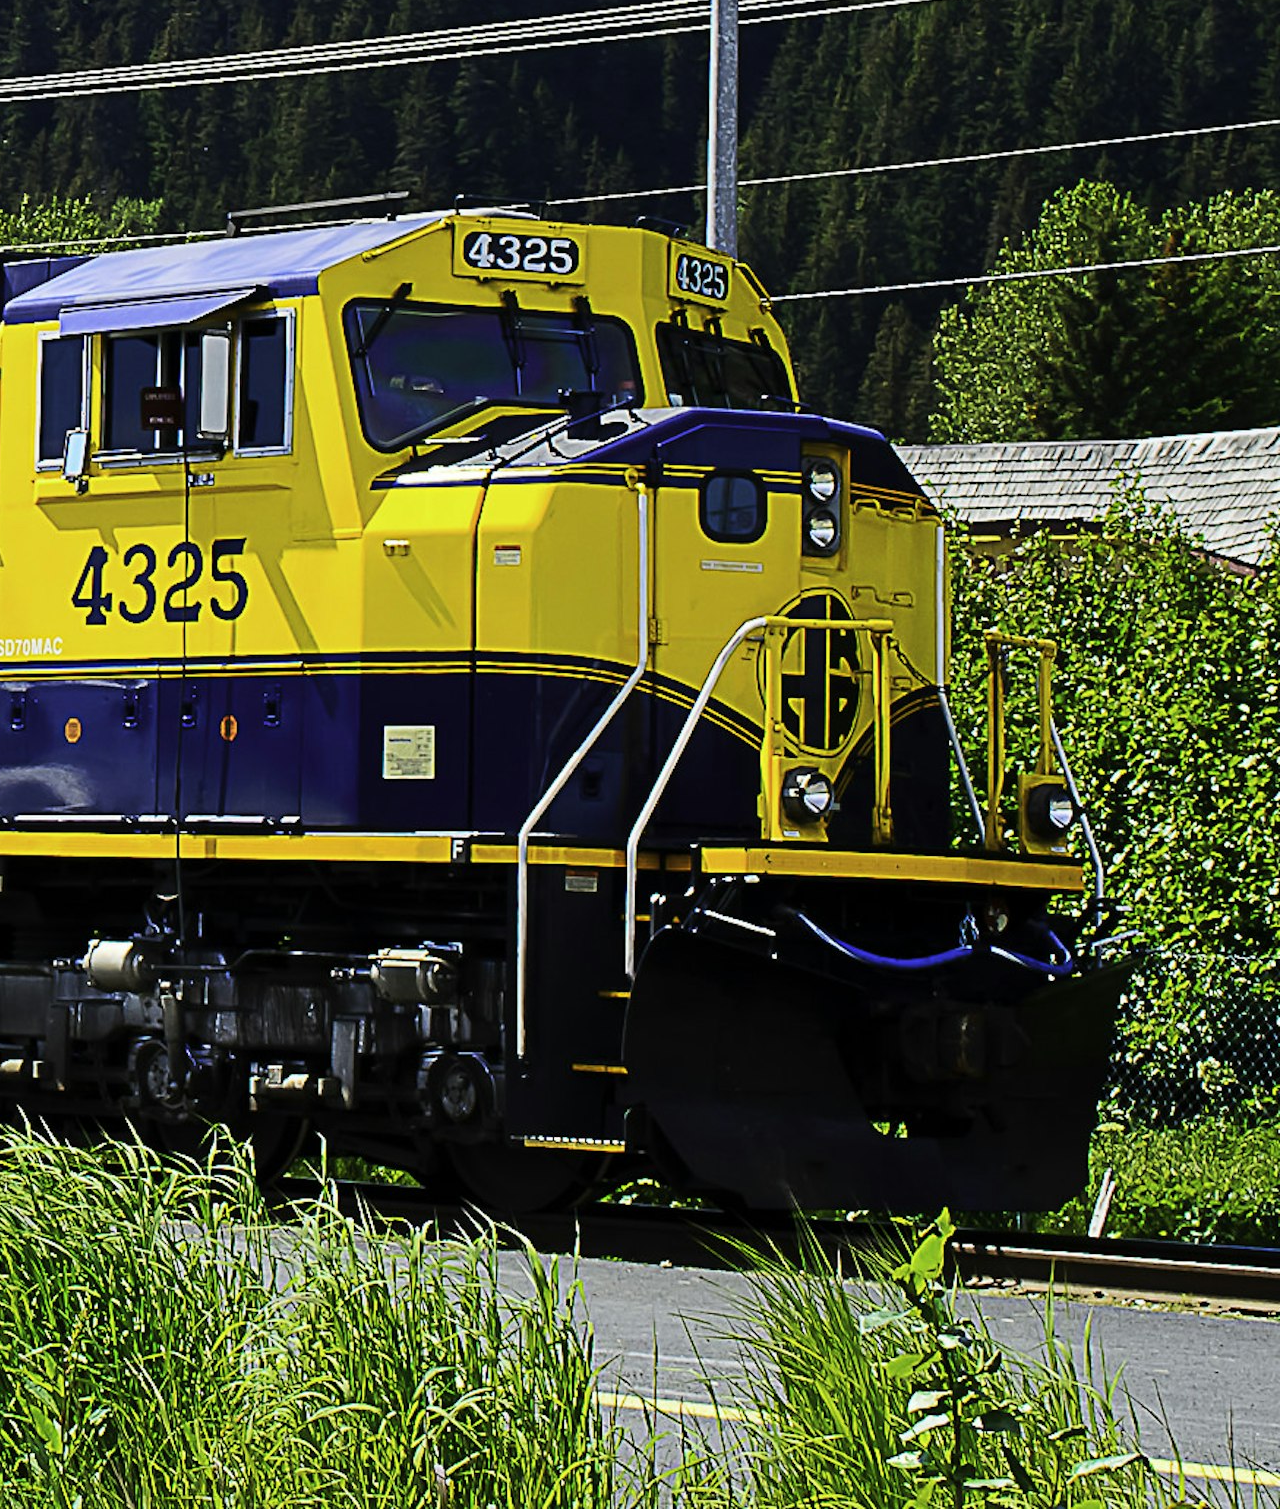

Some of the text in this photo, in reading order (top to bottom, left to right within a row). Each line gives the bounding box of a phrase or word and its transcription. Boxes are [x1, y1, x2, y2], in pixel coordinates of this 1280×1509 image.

[469, 234, 572, 274] 4325
[677, 257, 724, 298] 4325
[71, 538, 248, 625] 4325
[453, 839, 465, 860] F
